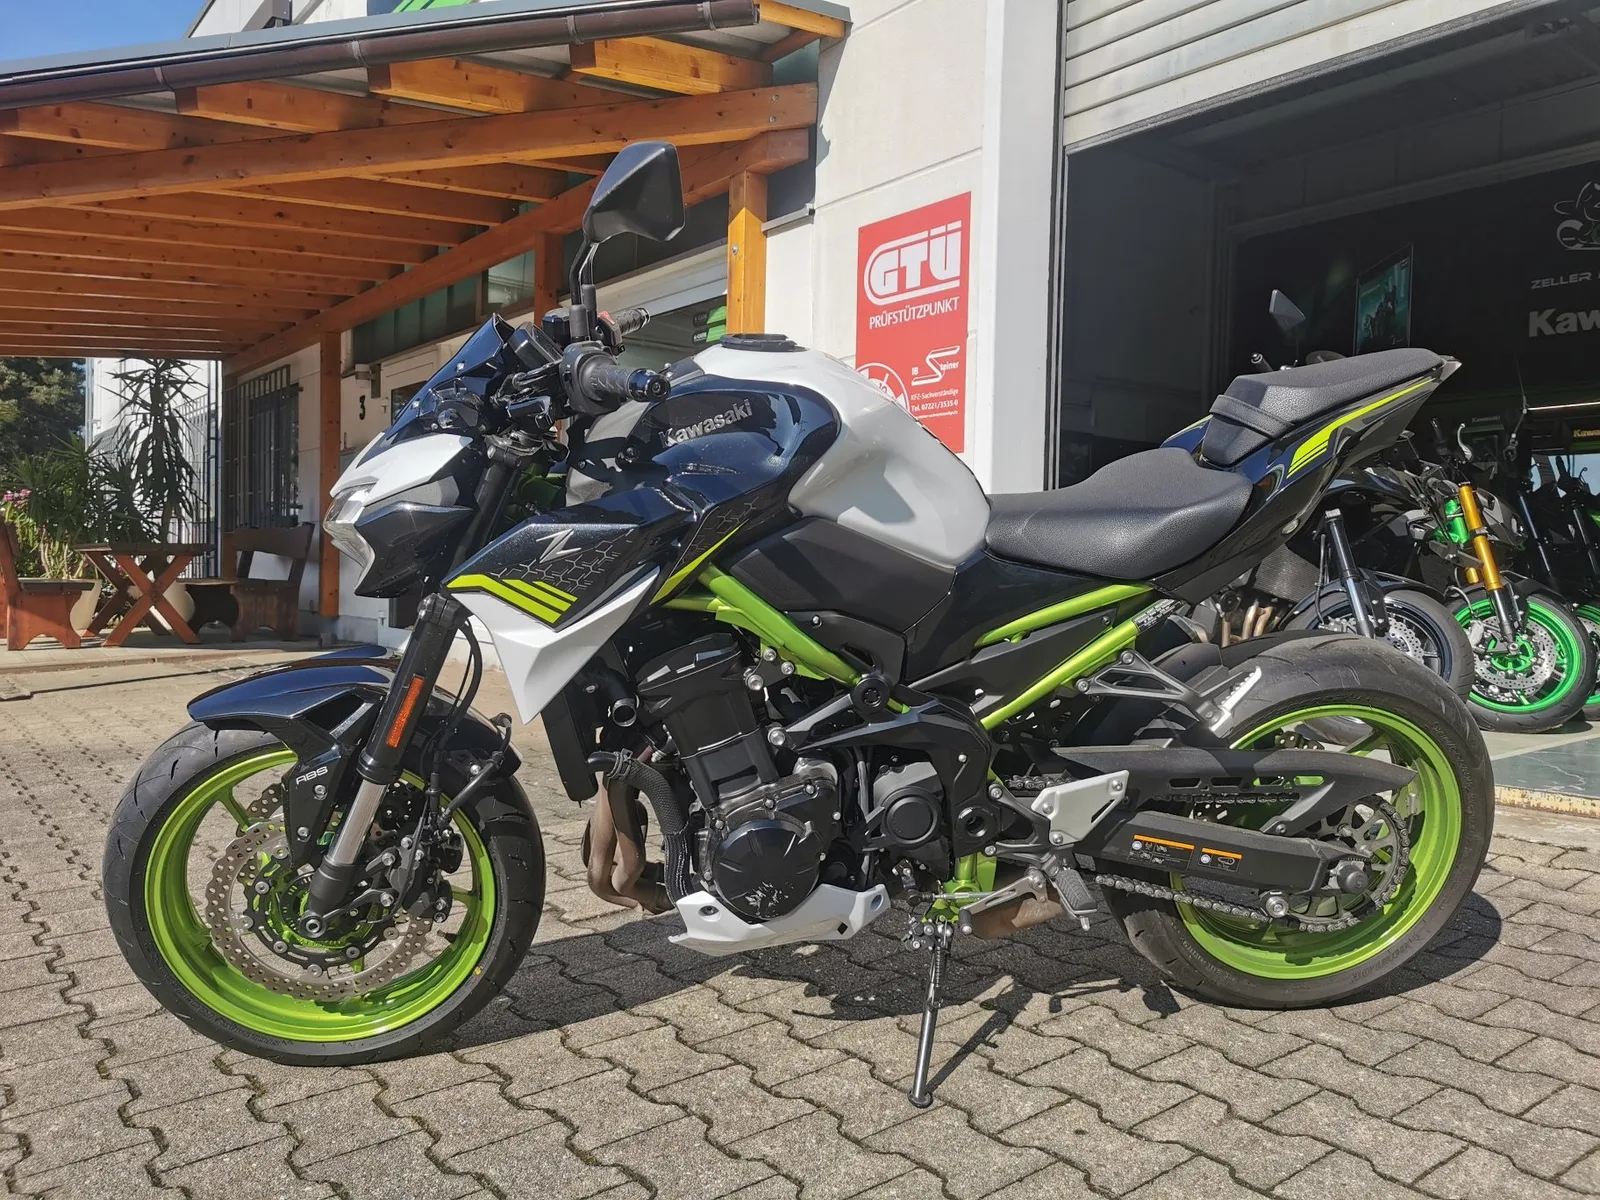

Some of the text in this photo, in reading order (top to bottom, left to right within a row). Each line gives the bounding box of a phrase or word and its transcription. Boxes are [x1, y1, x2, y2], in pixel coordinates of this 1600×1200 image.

[867, 220, 962, 298] GTÜ
[1531, 272, 1592, 289] ZELLER
[869, 296, 960, 329] PRÜFSTÜTZPUNKT
[1529, 308, 1600, 337] Kaw
[359, 394, 366, 420] 3
[659, 399, 753, 448] Kawasaki
[536, 528, 582, 564] Z
[296, 766, 329, 785] ABS
